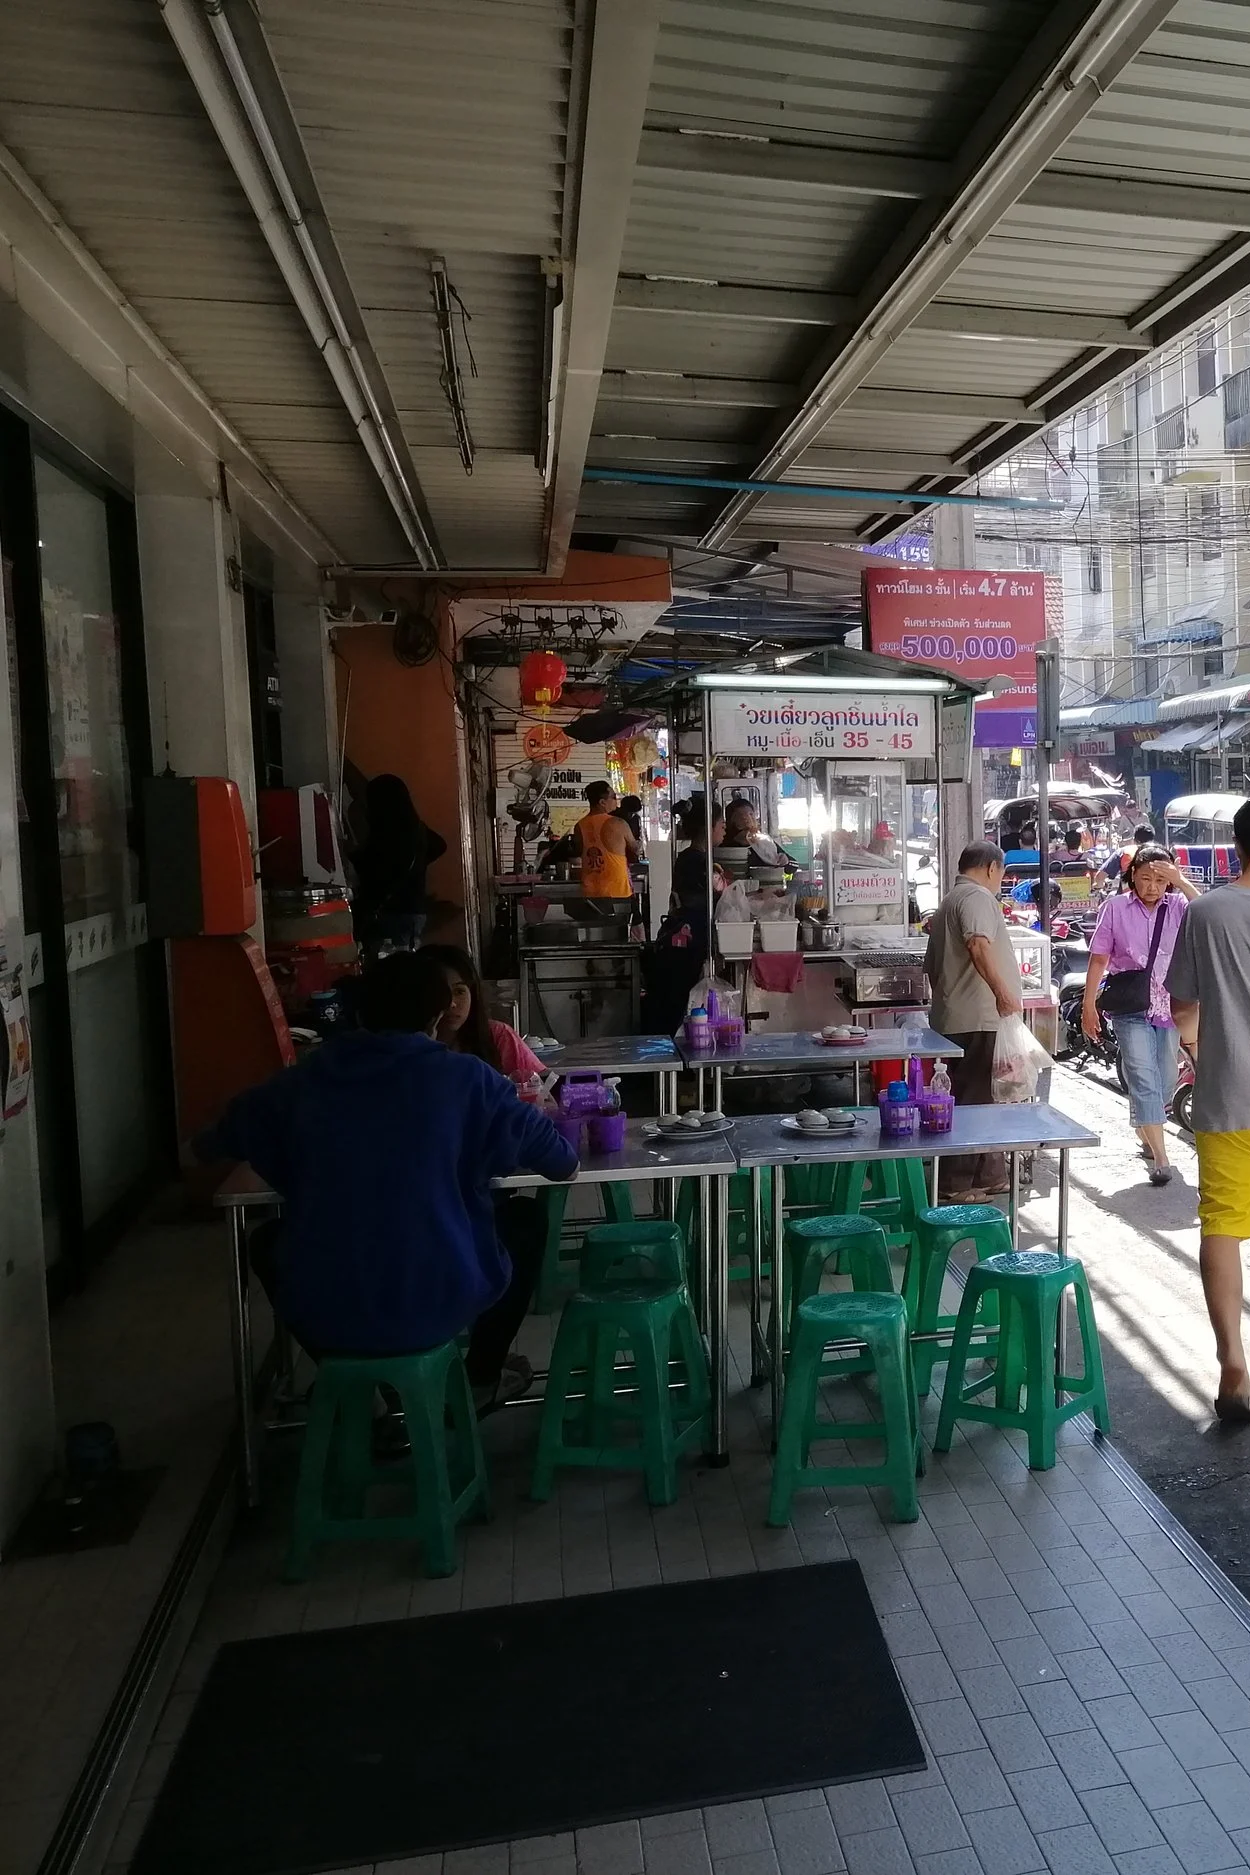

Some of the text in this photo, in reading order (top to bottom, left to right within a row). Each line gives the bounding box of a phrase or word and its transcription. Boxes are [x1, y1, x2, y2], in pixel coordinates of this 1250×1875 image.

[875, 579, 923, 595] ทาวน์โฮม
[926, 585, 932, 595] 3
[935, 578, 950, 595] ชั้น
[959, 580, 976, 596] เริ่ม
[978, 578, 1007, 596] 4.7
[901, 634, 1017, 665] 500,000
[843, 732, 869, 748] 35
[888, 733, 913, 749] 45
[840, 873, 896, 888] ขนมถ้วย
[884, 889, 896, 898] 20
